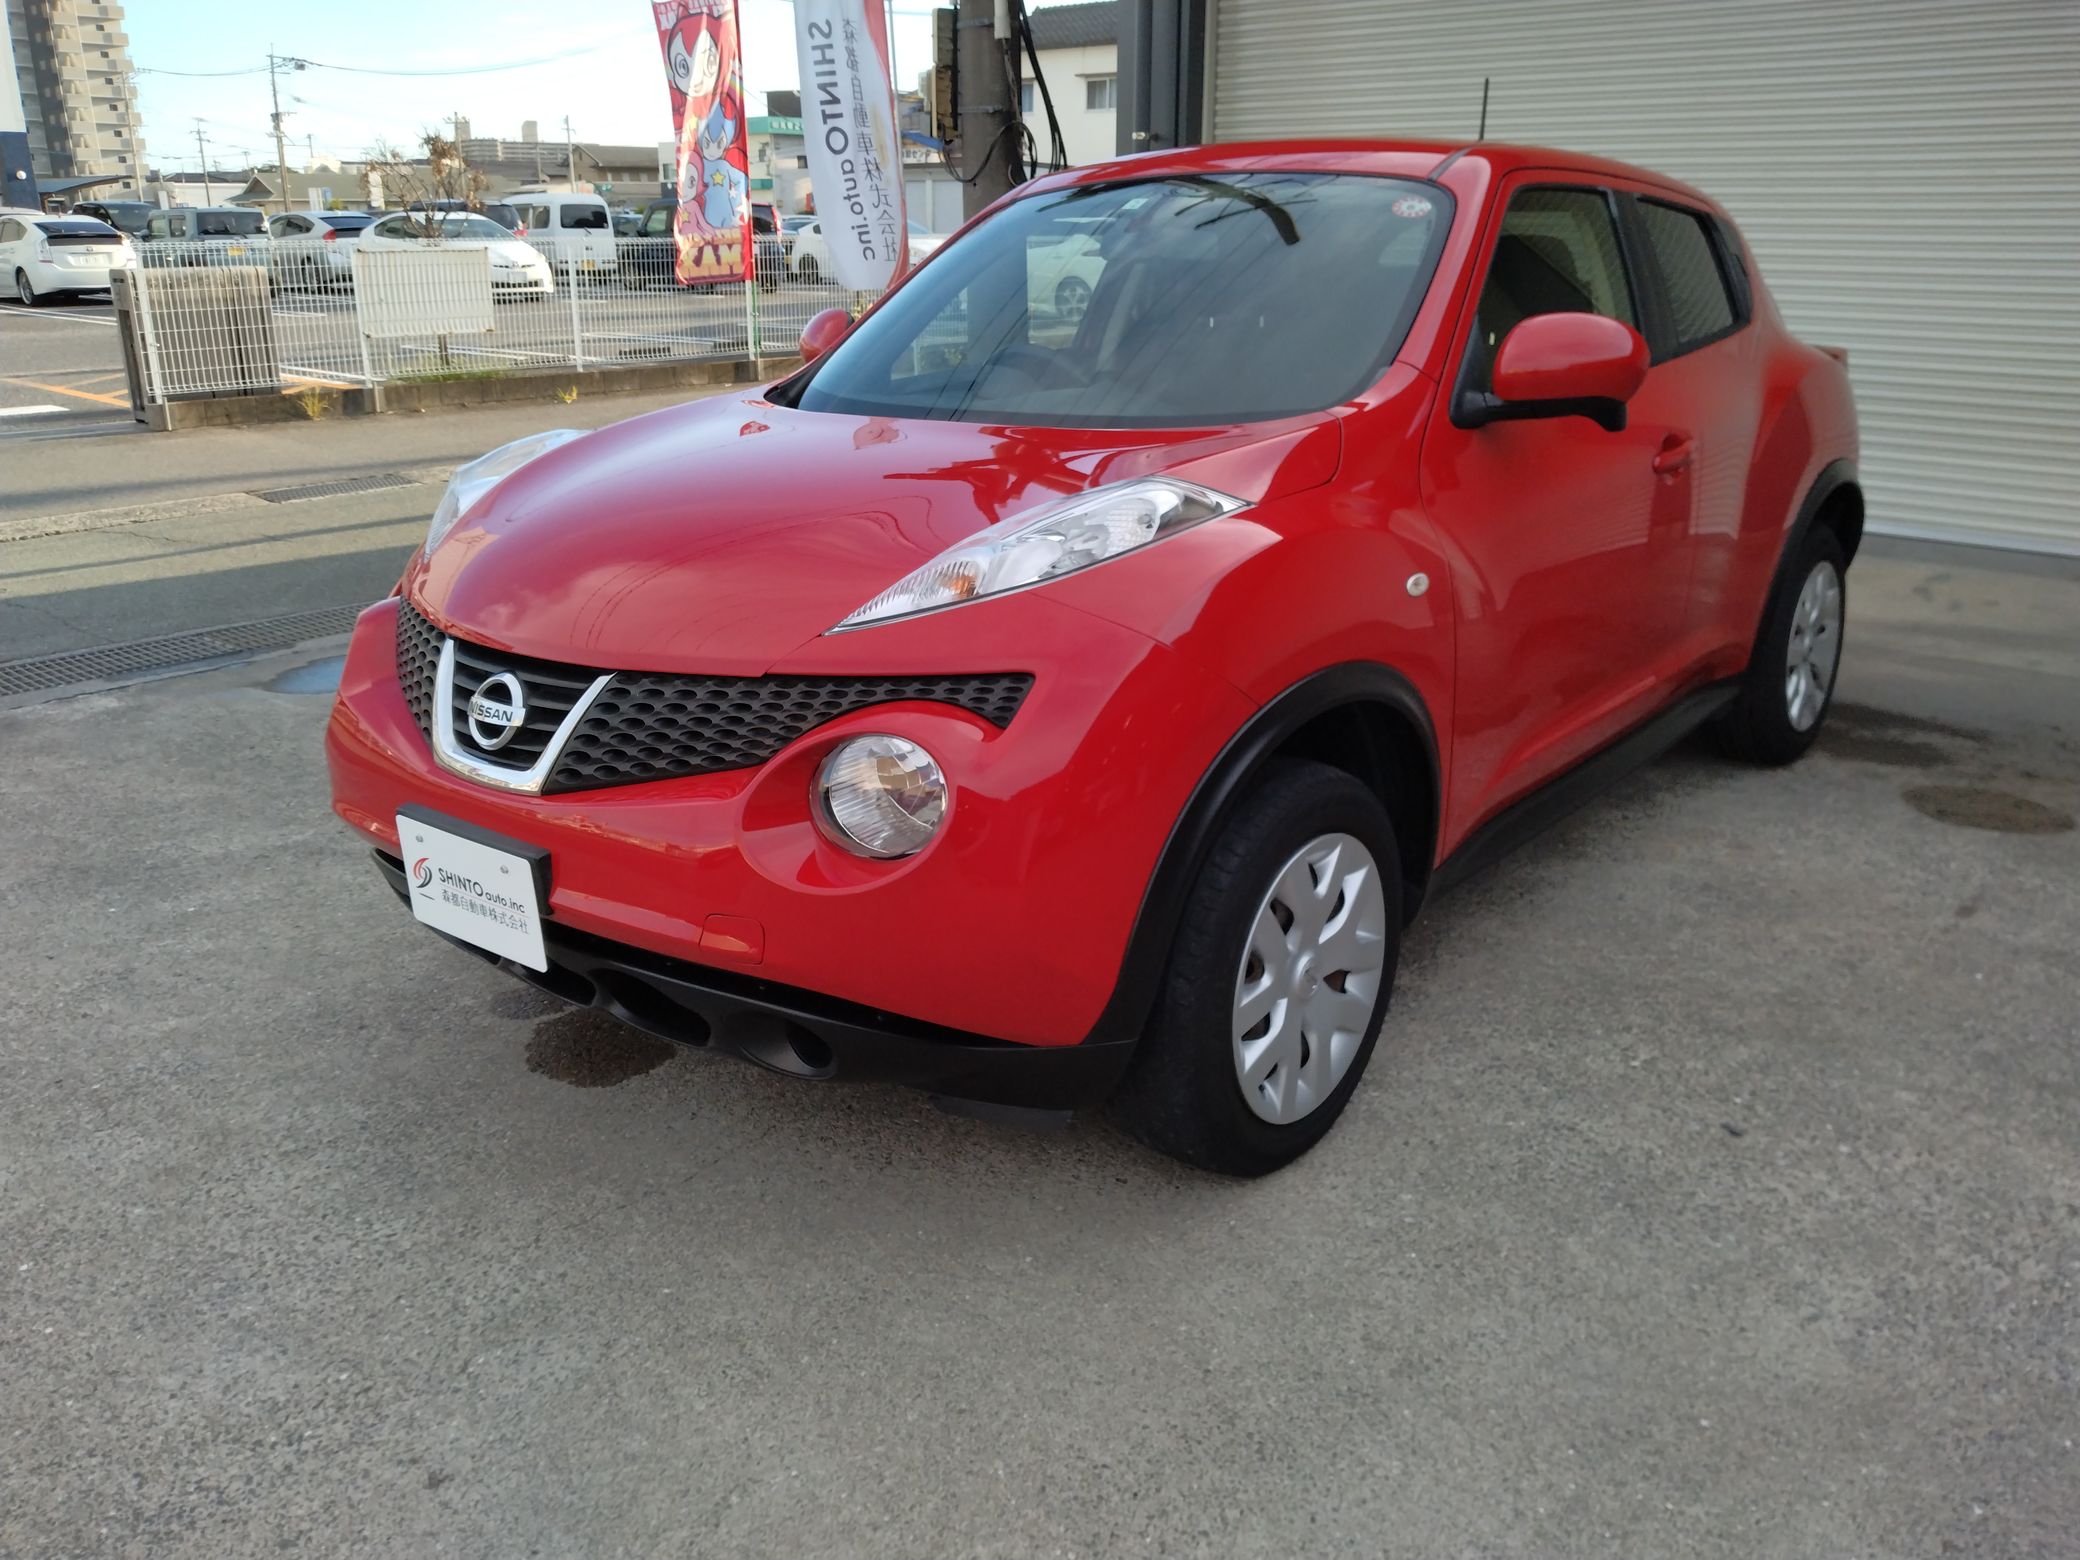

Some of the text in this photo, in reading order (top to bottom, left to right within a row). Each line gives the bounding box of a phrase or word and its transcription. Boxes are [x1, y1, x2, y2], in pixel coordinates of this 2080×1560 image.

[470, 700, 514, 722] NISSAN
[438, 867, 526, 914] SHINTO auto.inc
[441, 888, 529, 934] 森都自動車株式会社
